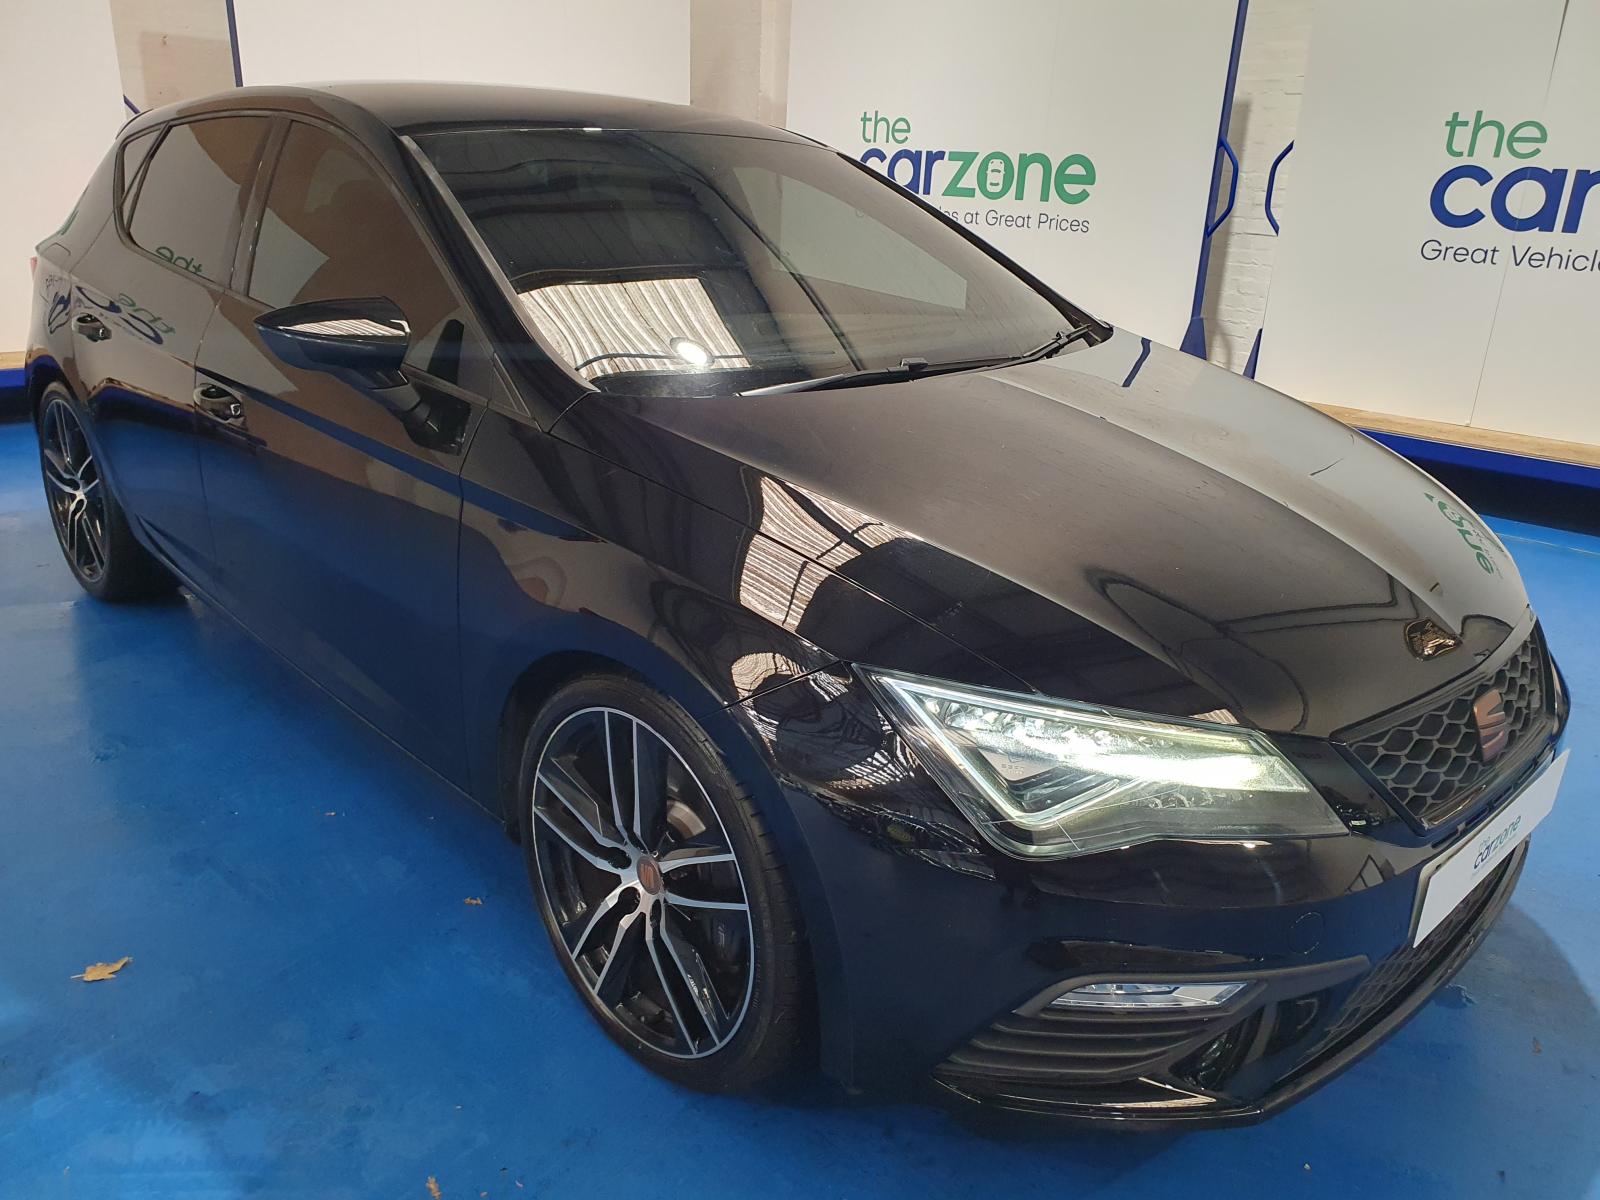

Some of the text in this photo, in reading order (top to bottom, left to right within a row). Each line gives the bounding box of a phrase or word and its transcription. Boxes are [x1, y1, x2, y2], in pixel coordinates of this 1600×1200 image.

[860, 110, 911, 144] the
[1445, 110, 1548, 159] the
[963, 210, 980, 226] at
[985, 209, 1032, 229] Great
[1037, 213, 1091, 233] Prices
[1420, 239, 1600, 272] Great Vehicl
